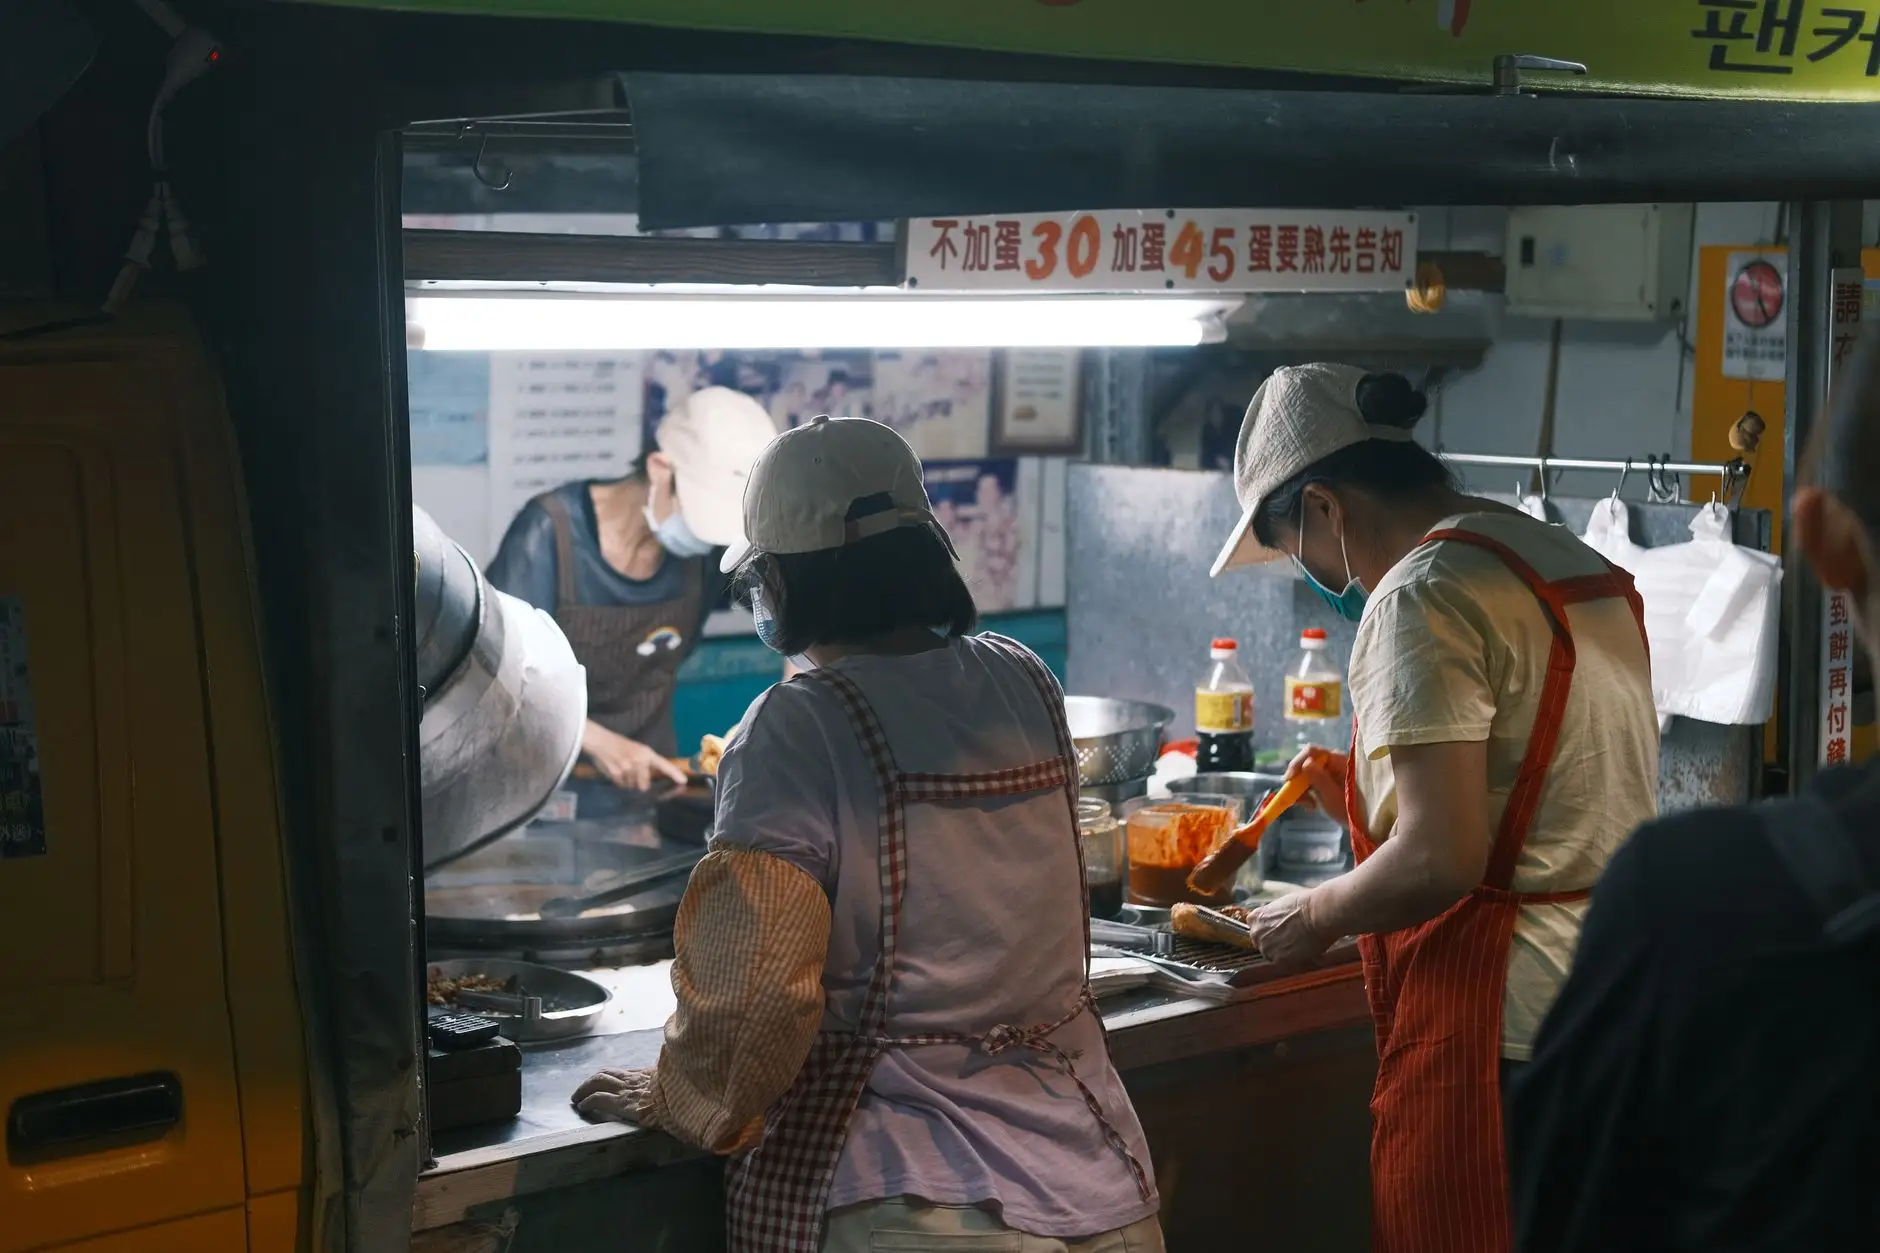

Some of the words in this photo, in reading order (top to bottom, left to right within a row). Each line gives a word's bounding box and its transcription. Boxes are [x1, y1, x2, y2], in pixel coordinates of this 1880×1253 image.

[930, 215, 1101, 280] 不加蛋30
[1111, 218, 1236, 283] 加蛋45
[1247, 223, 1403, 274] 蛋要熟先告知
